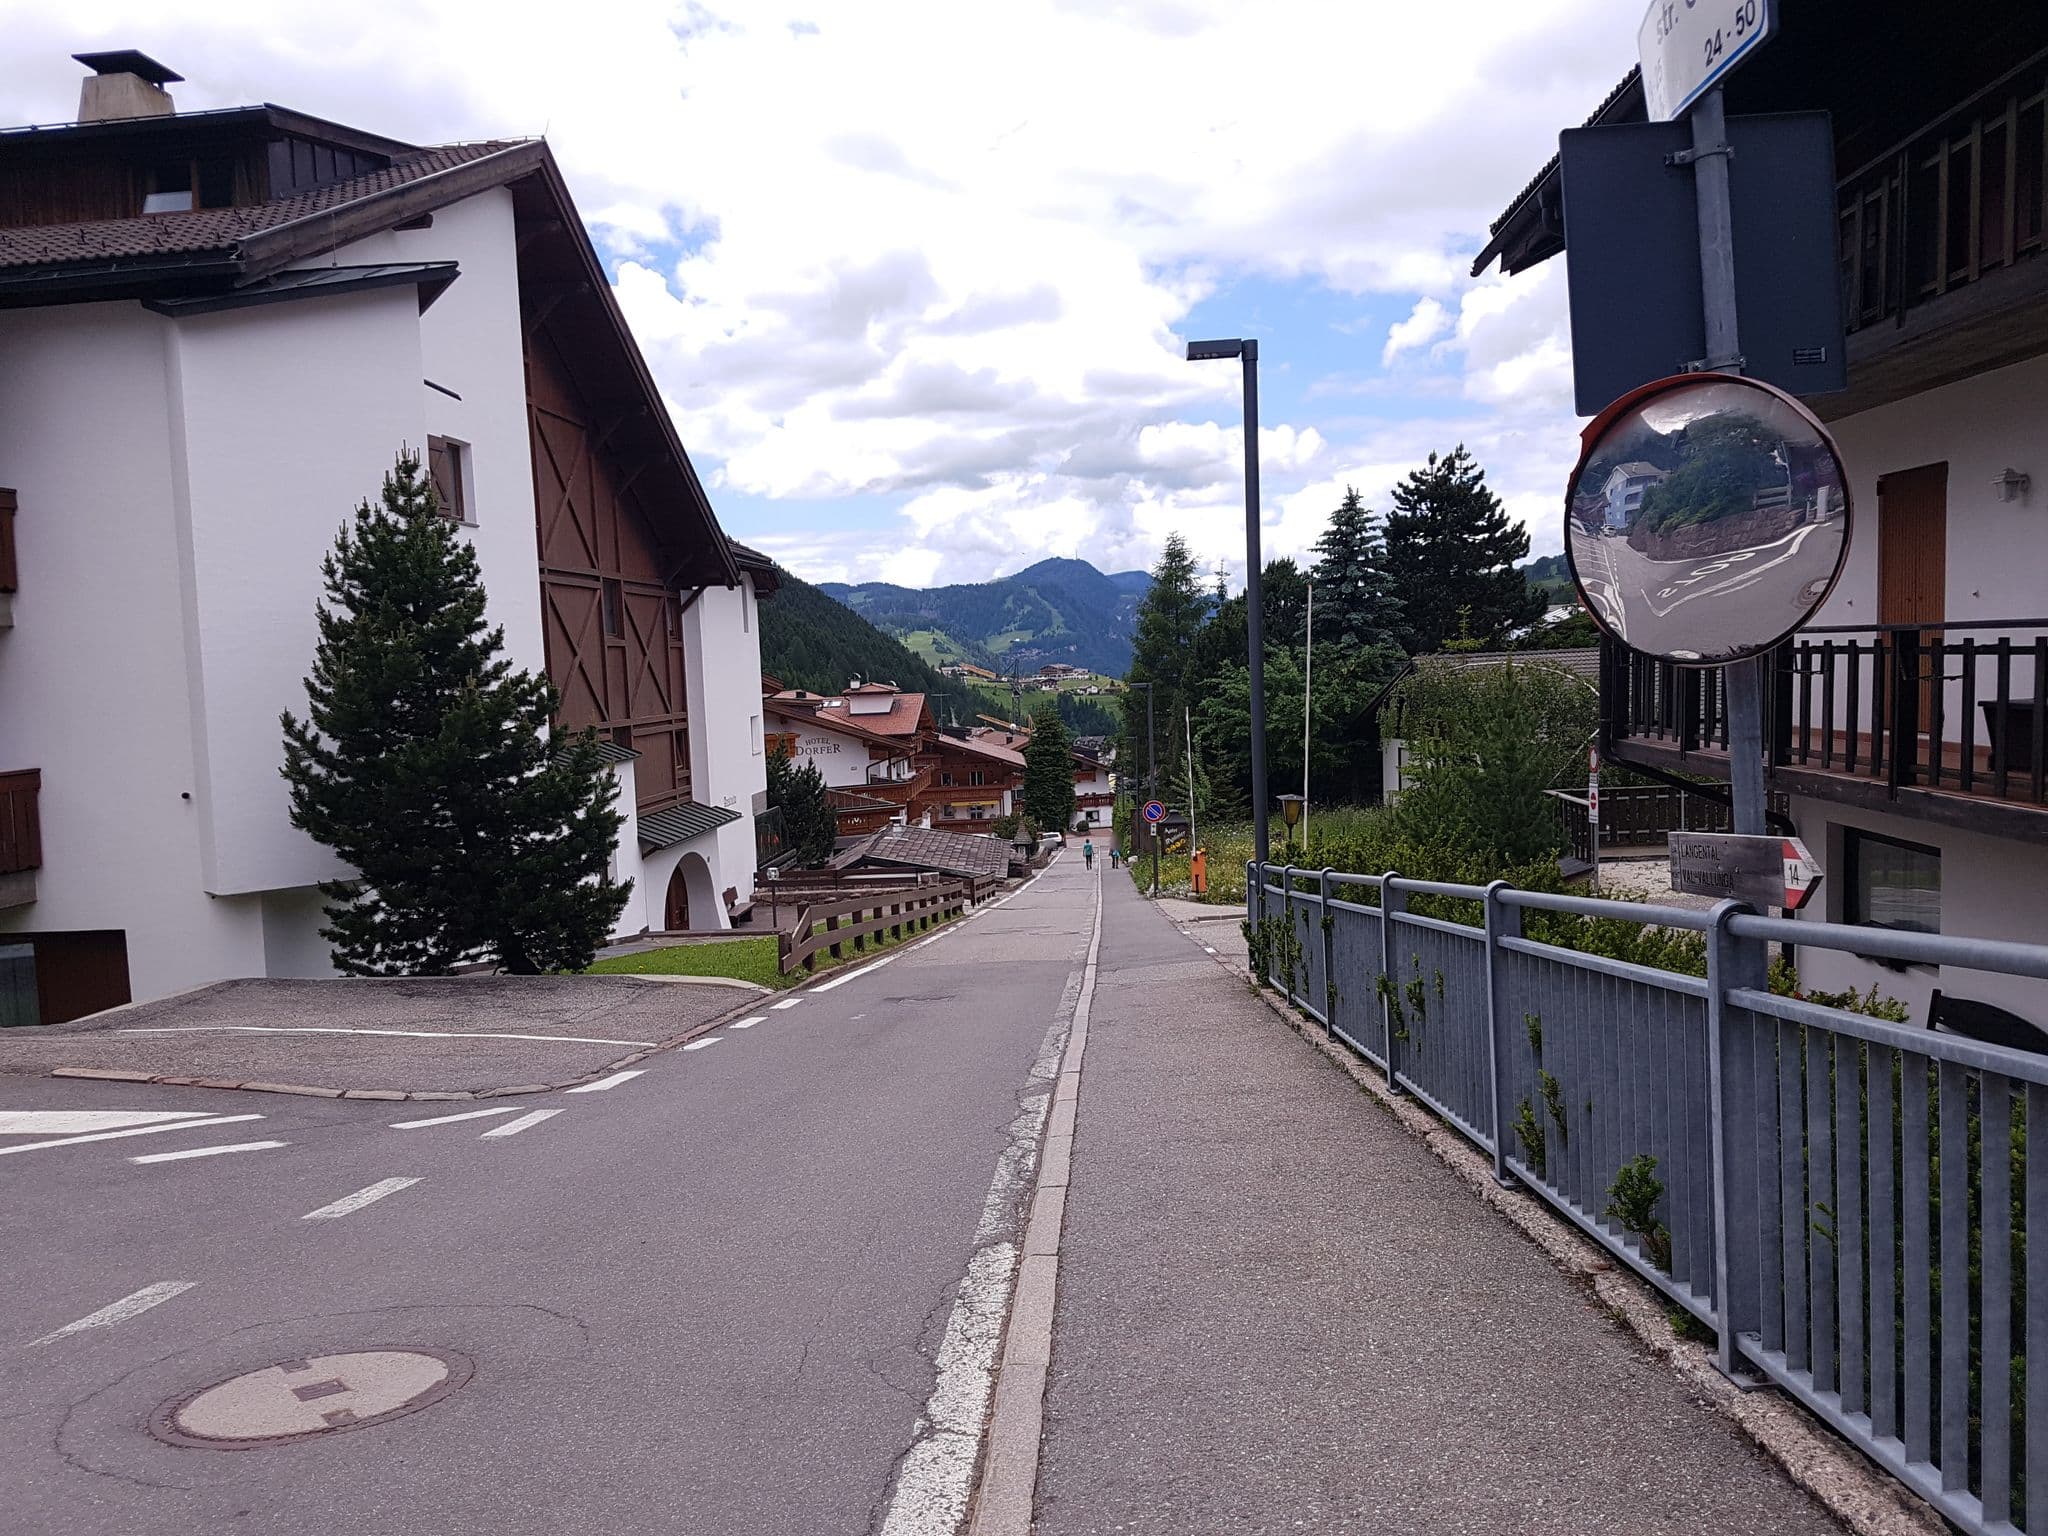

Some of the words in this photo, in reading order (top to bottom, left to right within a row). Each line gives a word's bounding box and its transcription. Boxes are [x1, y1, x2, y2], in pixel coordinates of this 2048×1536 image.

[1656, 3, 1679, 45] str.
[1704, 28, 1722, 67] 24
[1735, 0, 1756, 36] 50
[795, 743, 841, 756] DORFER
[805, 737, 831, 746] HOTEL
[1680, 844, 1721, 861] LANGENTAL
[1788, 863, 1799, 886] 14
